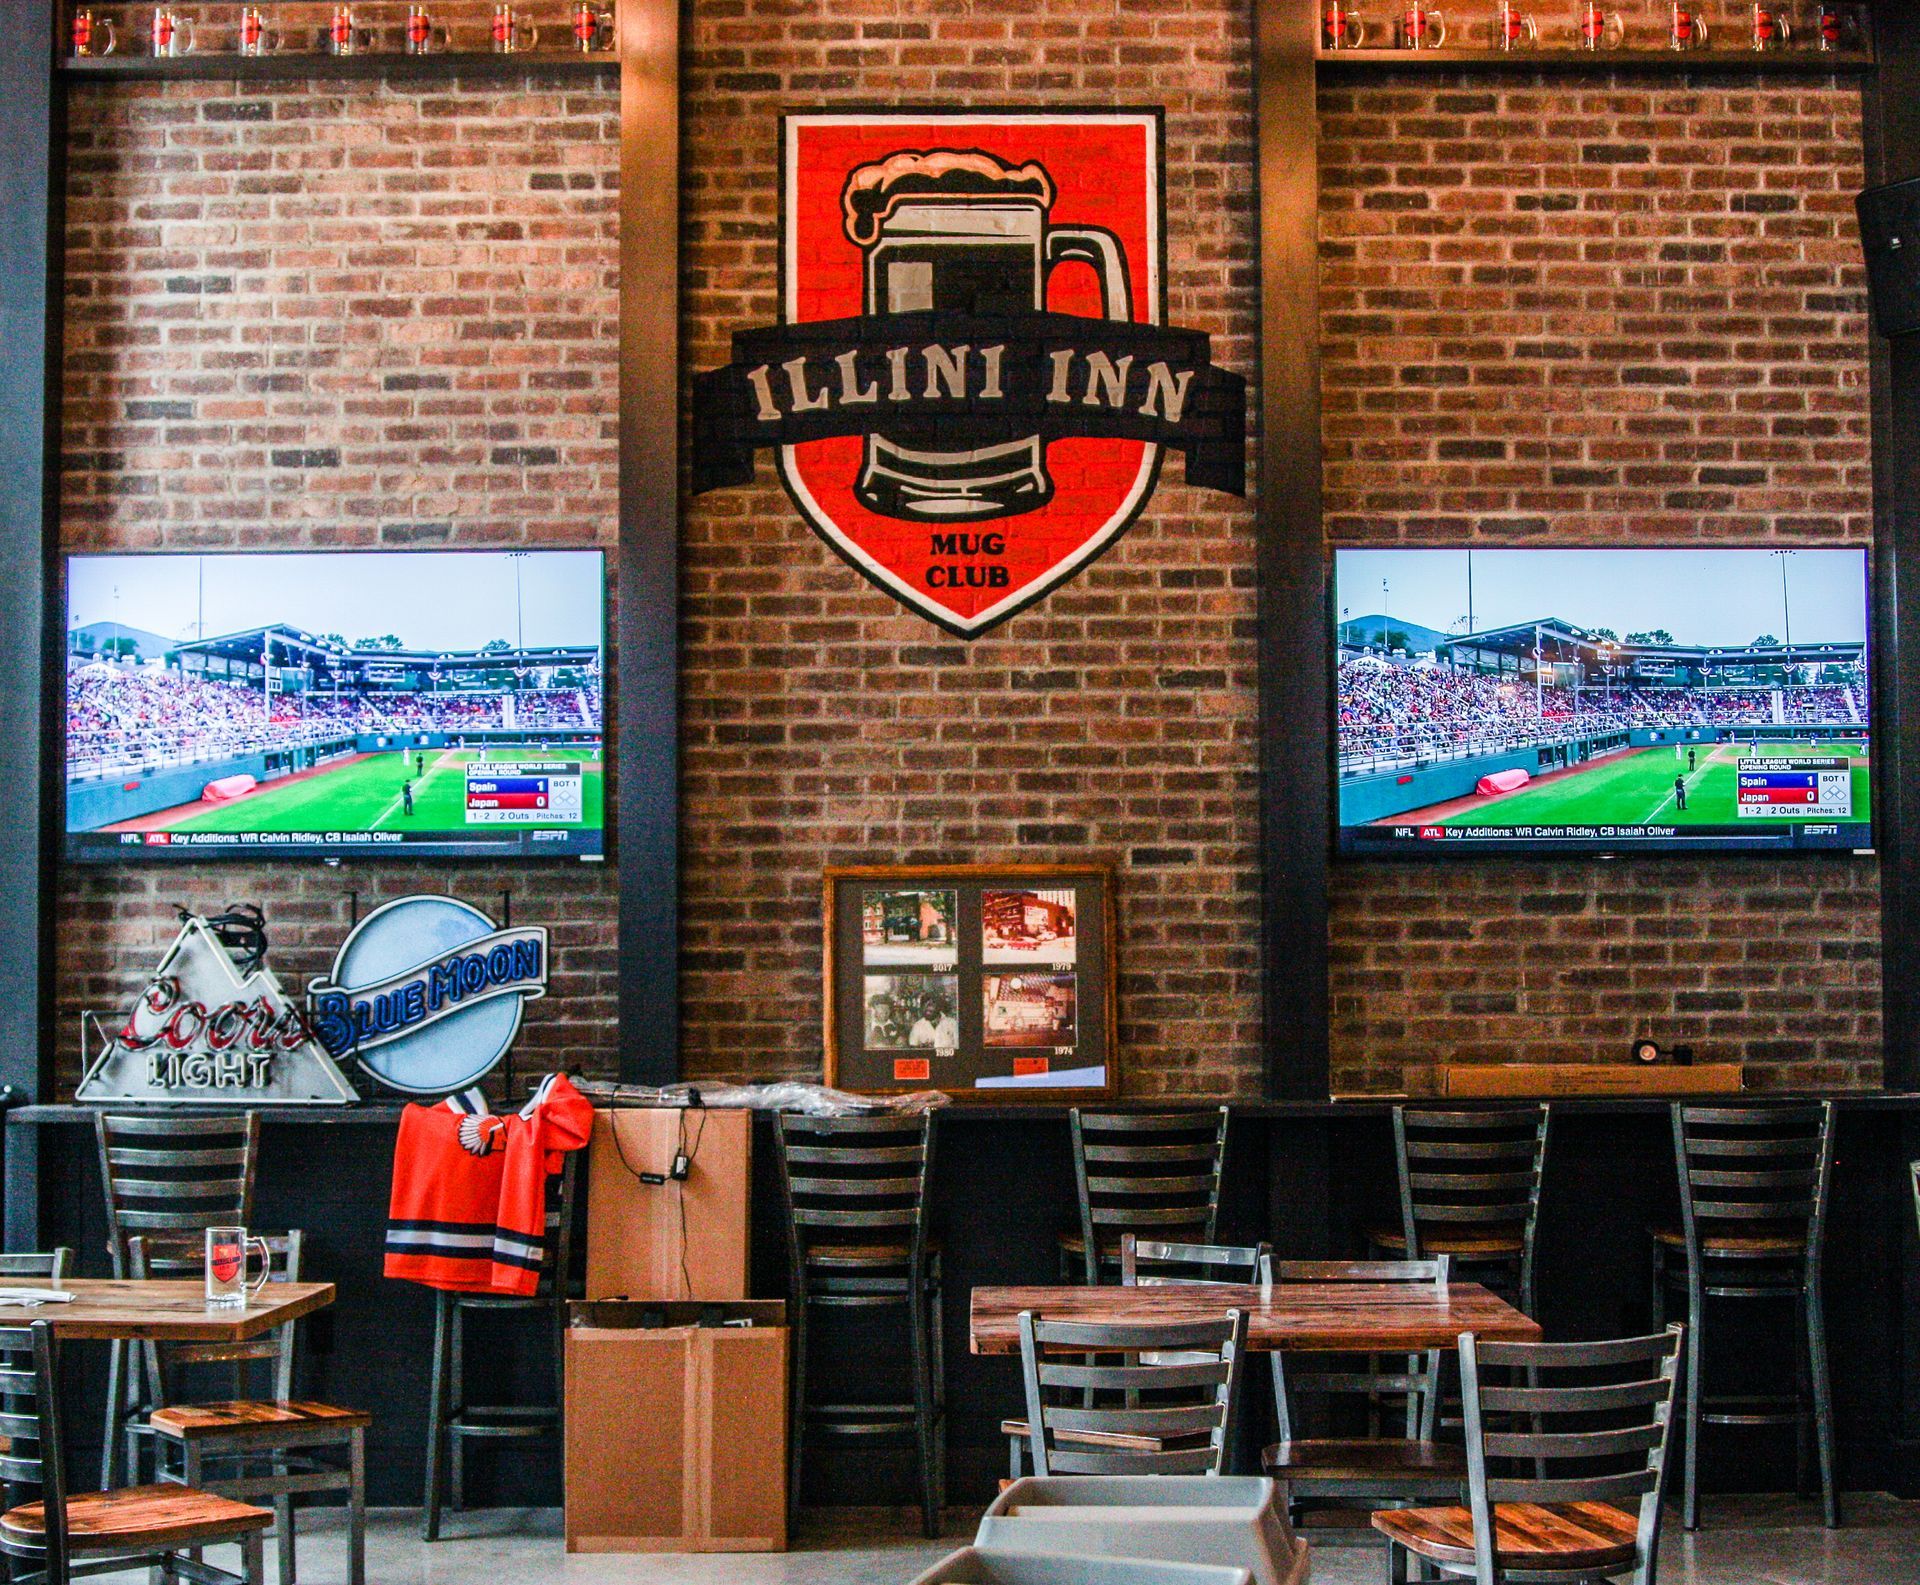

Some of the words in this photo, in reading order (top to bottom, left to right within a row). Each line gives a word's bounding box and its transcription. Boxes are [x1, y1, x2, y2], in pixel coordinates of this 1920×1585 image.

[747, 344, 1005, 421] ILLINI
[1046, 348, 1195, 422] INN
[929, 533, 1007, 556] MUG
[924, 566, 1011, 588] CLUB
[468, 782, 497, 793] Spain
[537, 781, 544, 791] 1
[1740, 777, 1767, 787] Spain
[1807, 776, 1814, 786] 1
[468, 798, 499, 808] Japan
[536, 796, 545, 807] 0
[1740, 793, 1769, 803] Japan
[1806, 791, 1815, 801] 0
[499, 812, 505, 820] 2
[508, 812, 529, 820] Outs
[568, 812, 578, 820] 12
[120, 833, 141, 844] NFL
[148, 833, 167, 843] ATL
[170, 833, 190, 845] Key
[190, 833, 239, 843] Additions:
[240, 833, 259, 843] WR
[259, 832, 290, 843] Calvin
[291, 832, 324, 844] Ridley,
[325, 832, 341, 842] CB
[342, 832, 371, 842] Isaiah
[373, 832, 403, 842] Oliver
[532, 830, 568, 841] ESPN
[1395, 828, 1414, 837] NFL
[1423, 828, 1440, 837] ATL
[1445, 827, 1463, 838] Key
[1465, 827, 1513, 837] Additions:
[1515, 827, 1532, 836] WR
[1534, 827, 1564, 836] Calvin
[1566, 827, 1598, 837] Ridley,
[1600, 826, 1615, 836] CB
[1617, 826, 1645, 836] Isaiah
[1647, 826, 1675, 836] Oliver
[1804, 825, 1837, 834] ESPN
[932, 963, 953, 972] 2017
[117, 976, 316, 1051] Coors
[146, 1052, 272, 1090] LIGHT
